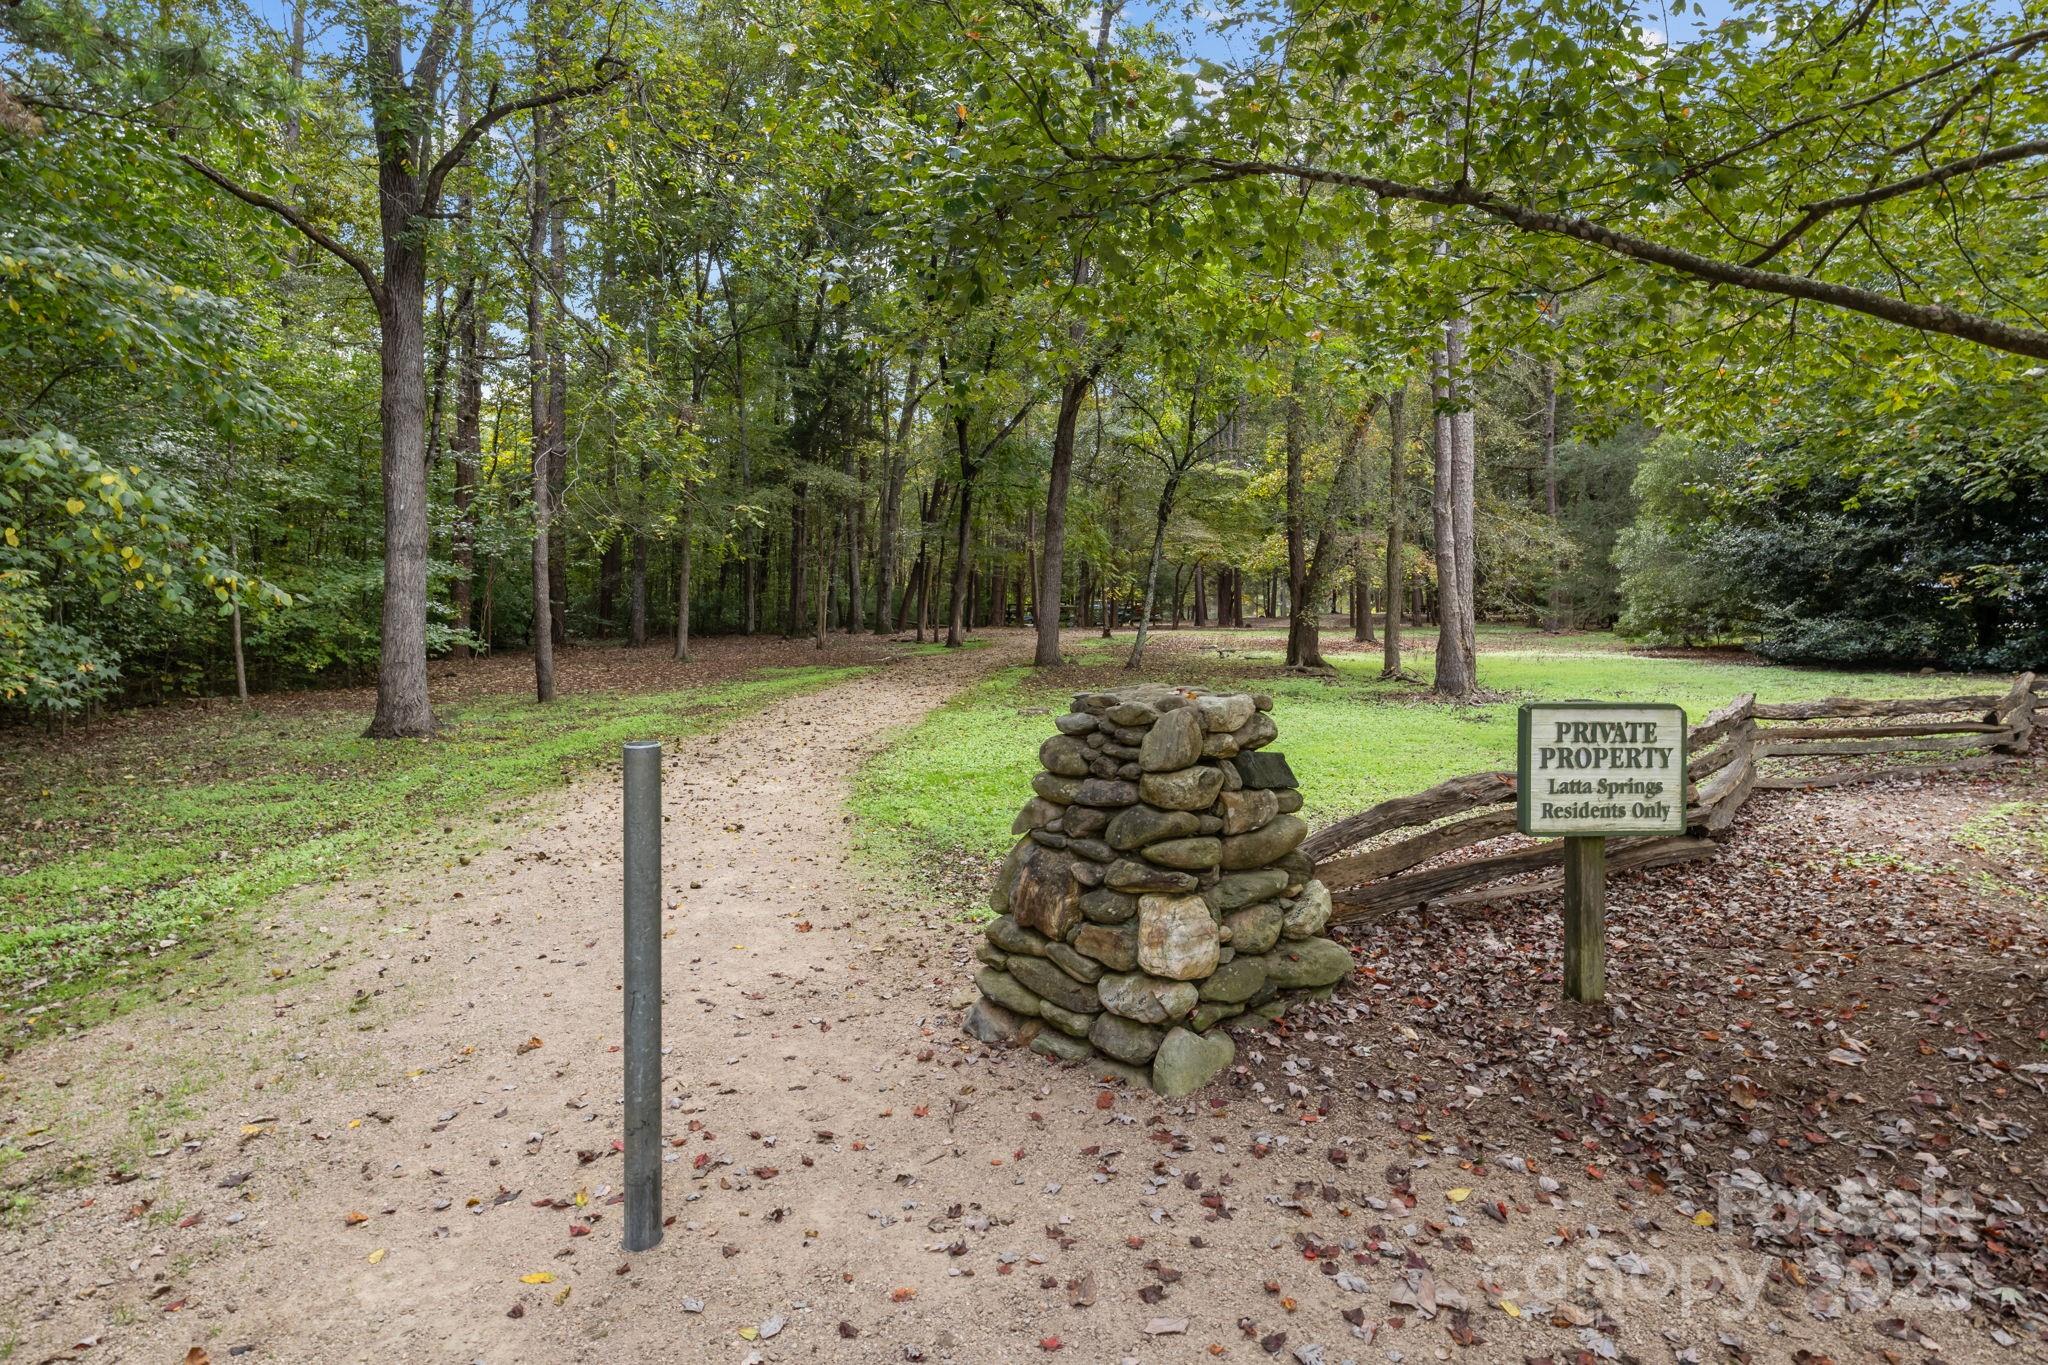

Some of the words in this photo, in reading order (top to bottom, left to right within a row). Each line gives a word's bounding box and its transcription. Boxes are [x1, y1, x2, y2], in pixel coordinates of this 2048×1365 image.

[1554, 721, 1658, 744] PRIVATE
[1538, 747, 1674, 769] PROPERTY
[1547, 778, 1592, 795] Latta
[1596, 777, 1664, 799] Springs
[1540, 802, 1627, 819] Residents
[1631, 801, 1671, 822] Only
